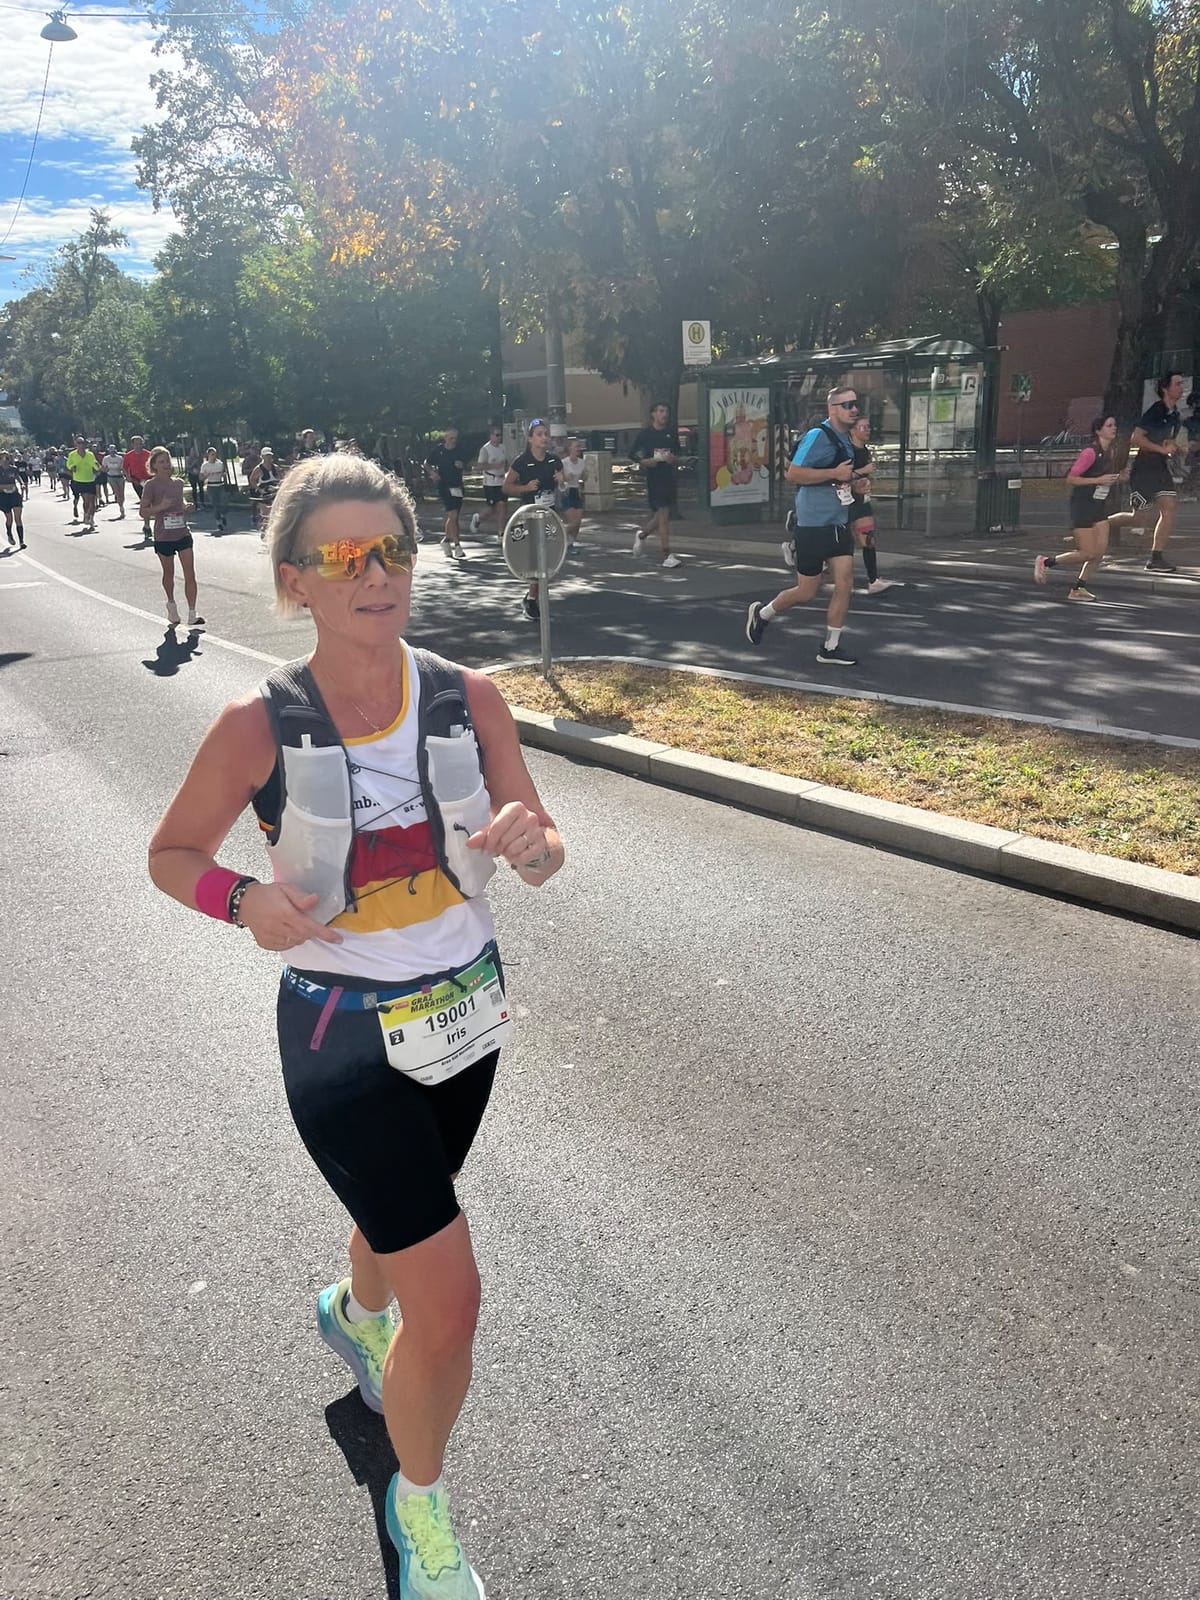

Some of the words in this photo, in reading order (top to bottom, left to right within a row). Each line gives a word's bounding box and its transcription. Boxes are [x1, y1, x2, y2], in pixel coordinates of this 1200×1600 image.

[692, 326, 702, 340] H
[410, 991, 455, 1013] MARATHON
[411, 993, 434, 1006] GRAZ
[425, 995, 476, 1032] 19001
[394, 1034, 401, 1043] 2
[446, 1026, 467, 1045] Iris
